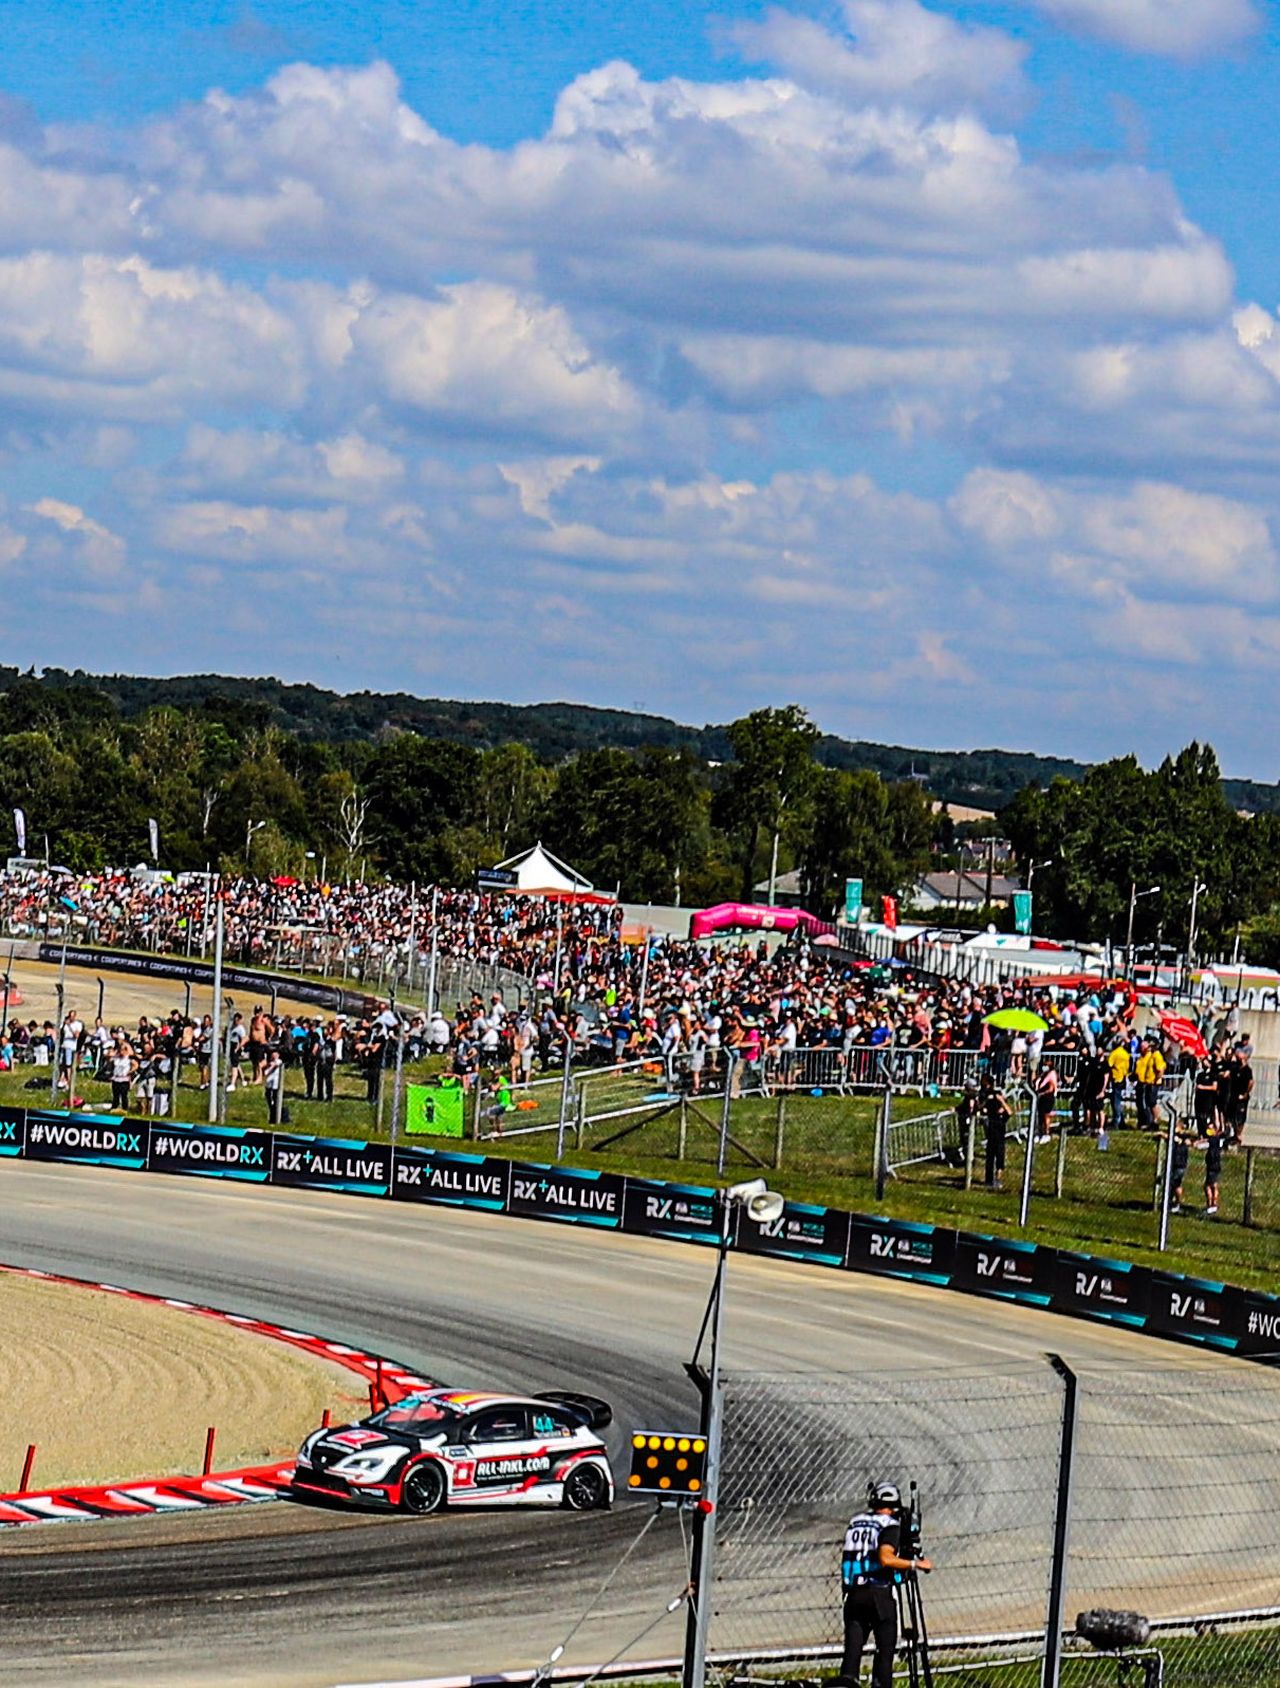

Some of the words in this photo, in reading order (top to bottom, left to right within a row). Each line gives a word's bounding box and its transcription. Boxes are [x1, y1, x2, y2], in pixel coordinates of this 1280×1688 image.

[30, 1123, 141, 1152] #WORLDRX
[155, 1135, 264, 1164] #WORLDRX
[346, 1160, 384, 1181] LIVE
[465, 1174, 502, 1196] LIVE
[580, 1189, 616, 1211] LIVE
[646, 1196, 673, 1219] RX
[870, 1234, 896, 1258] RX
